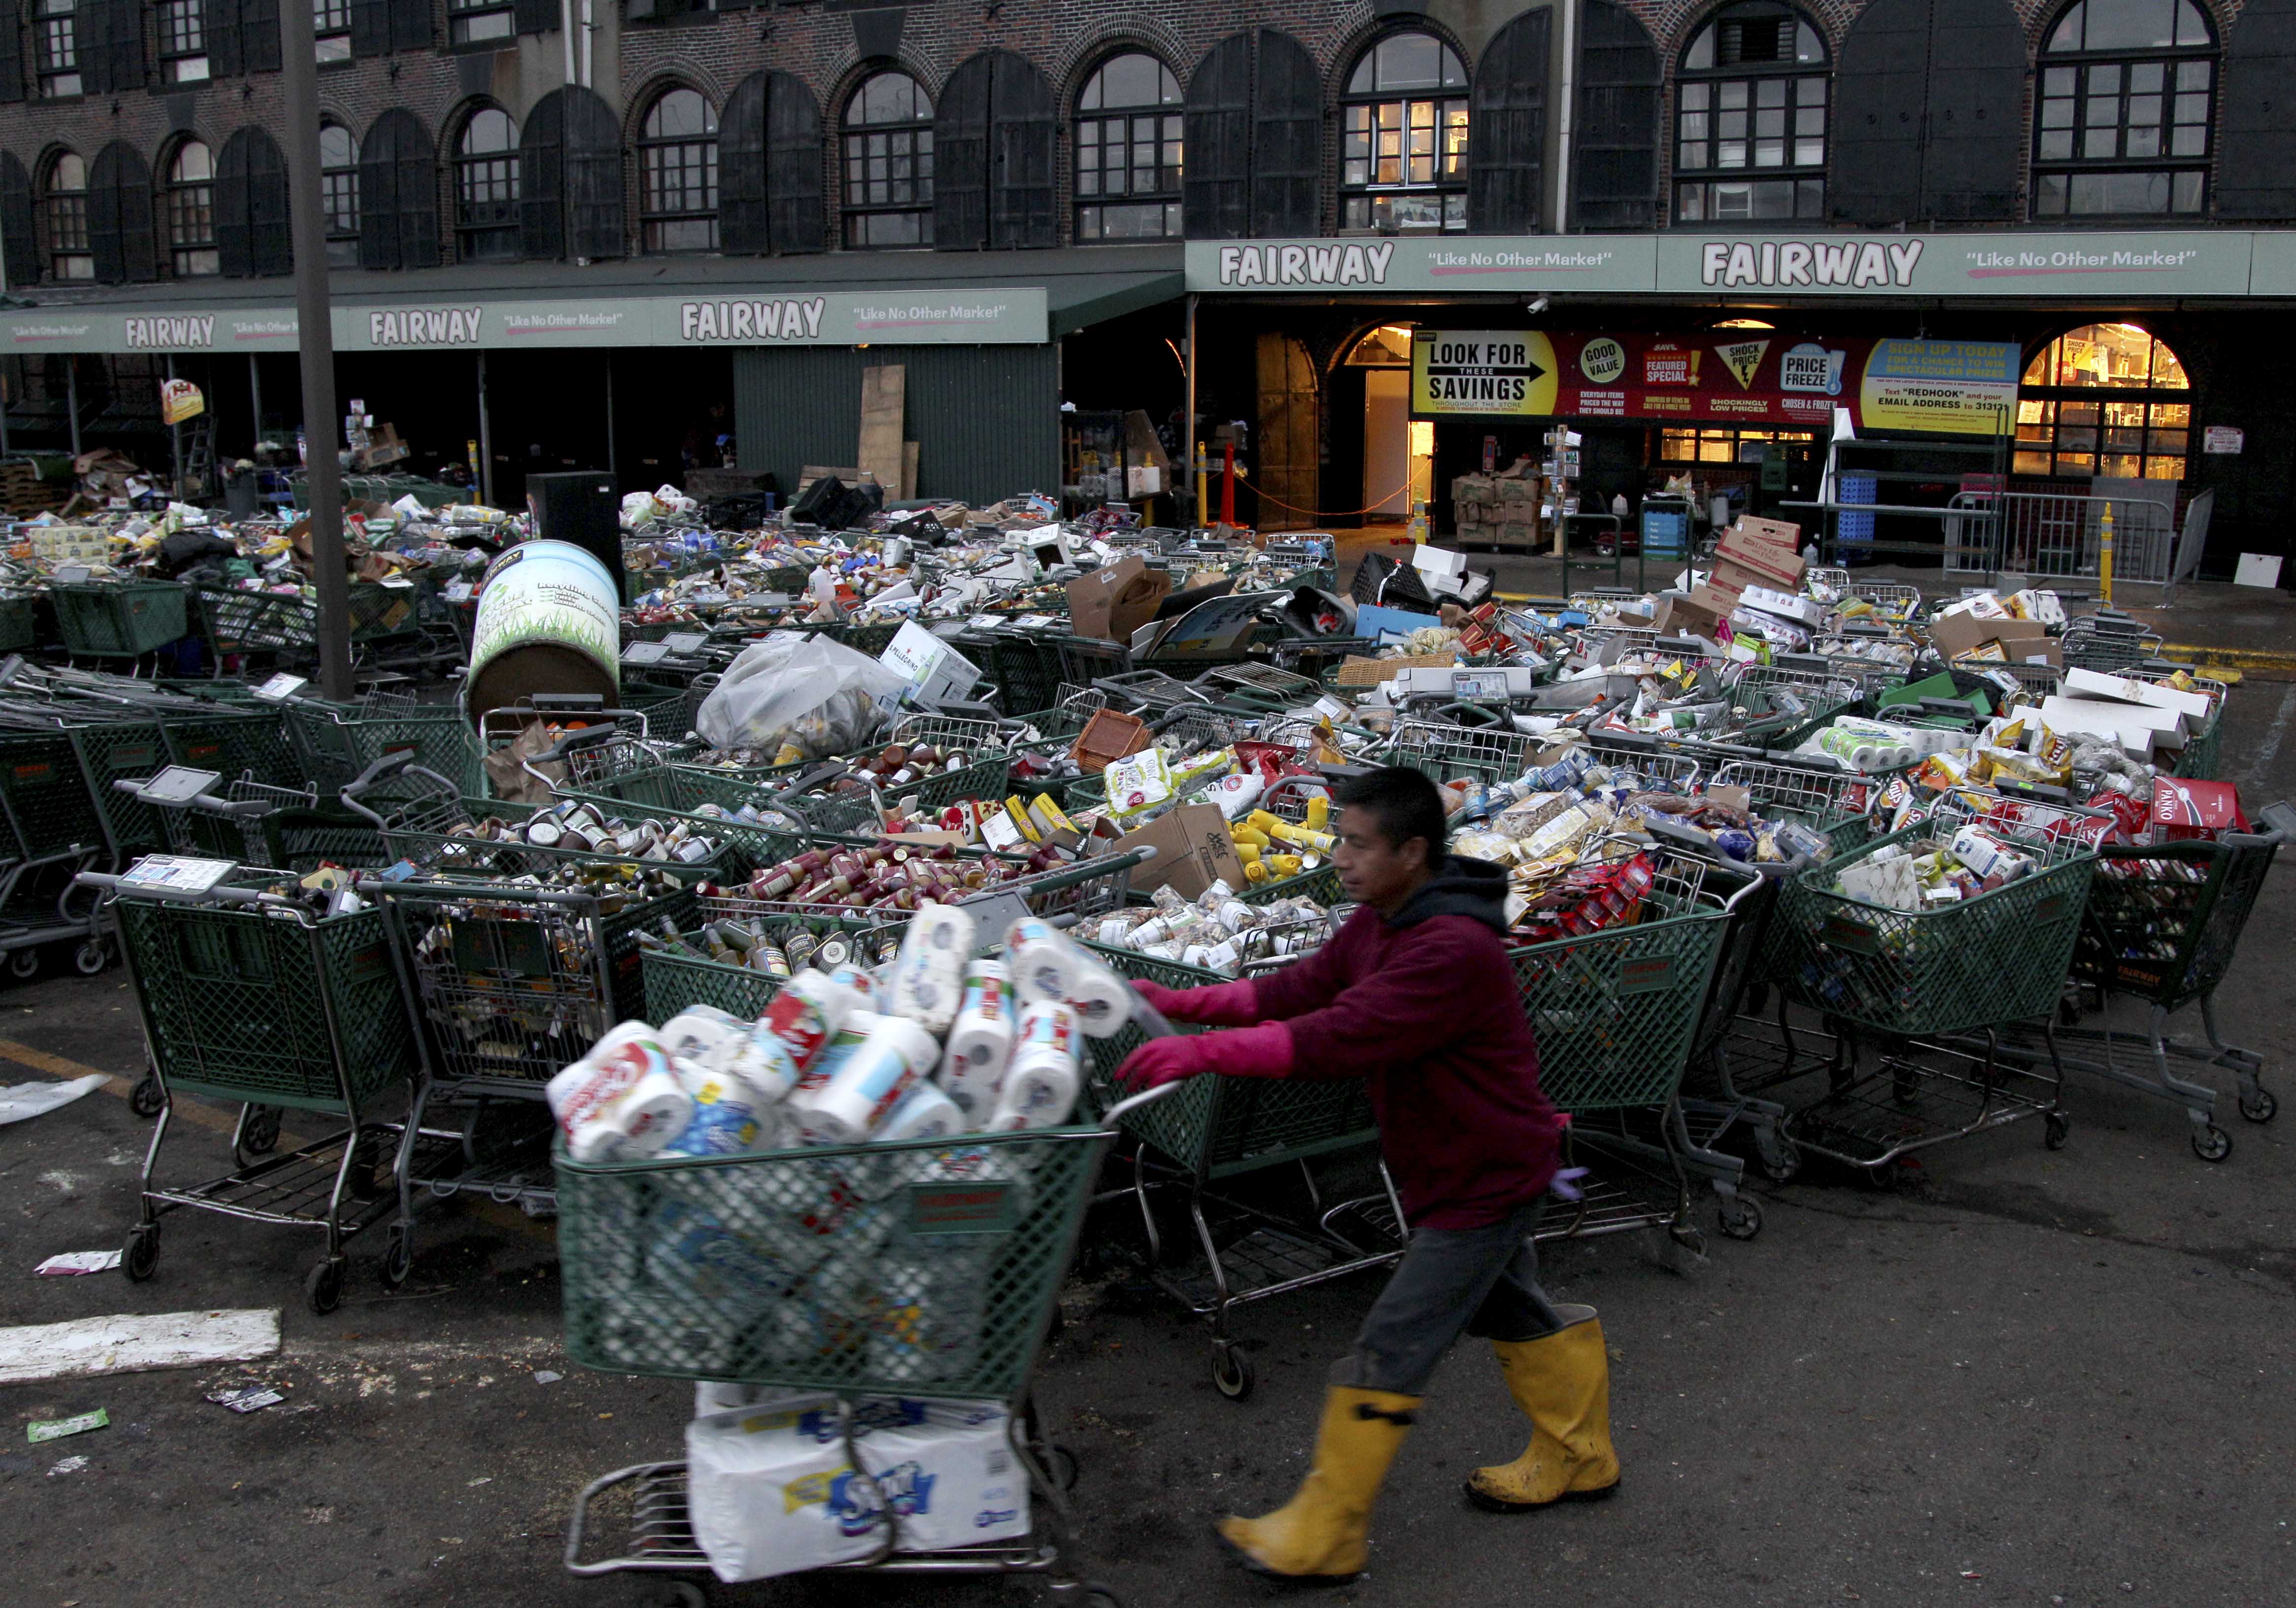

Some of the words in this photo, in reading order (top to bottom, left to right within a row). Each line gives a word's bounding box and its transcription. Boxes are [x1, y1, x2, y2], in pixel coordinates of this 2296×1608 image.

[1220, 241, 1394, 286] FAIRWAY
[1429, 252, 1467, 265] "Like
[1471, 253, 1492, 265] No
[1496, 252, 1541, 265] Other
[1545, 252, 1612, 265] Market"
[1701, 239, 1924, 288] FAIRWAY
[1967, 252, 2015, 267] "Like
[2020, 253, 2046, 267] No
[2051, 251, 2108, 267] Other
[2113, 250, 2196, 266] Market"
[681, 297, 825, 341] FAIRWAY
[889, 308, 907, 319] No
[910, 305, 947, 319] Other
[370, 306, 482, 345] FAIRWAY
[532, 315, 546, 325] No
[548, 314, 576, 325] Other
[126, 314, 214, 348] FAIRWAY
[1430, 343, 1480, 364] LOOK
[1486, 344, 1525, 365] FOR
[1585, 344, 1616, 362] GOOD
[1729, 344, 1759, 356] SHOCK
[1889, 343, 1925, 354] SIGN
[1930, 344, 1951, 355] UP
[1956, 345, 2007, 357] TODAY
[1647, 361, 1686, 370] FEATURED
[1732, 355, 1758, 366] PRICE
[1787, 358, 1826, 372] PRICE
[1922, 357, 1963, 366] CHANCE
[1985, 360, 2005, 368] WIN
[1589, 360, 1620, 376] VALUE
[1886, 365, 1962, 375] SPECTACULAR
[1966, 368, 2005, 378] PRIZES
[1647, 371, 1686, 382] SPECIAL
[1786, 374, 1825, 386] FREEZE
[1429, 377, 1525, 400] SAVINGS
[1903, 388, 1964, 398] "REDHOOK"
[1782, 399, 1805, 408] CHOSEN
[1806, 400, 1811, 409] &
[1878, 398, 1909, 406] EMAIL
[1913, 400, 1960, 408] ADDRESS
[538, 582, 590, 600] Recycling
[889, 644, 918, 671] S.PELLEGRINO
[2161, 789, 2173, 820] PANKO
